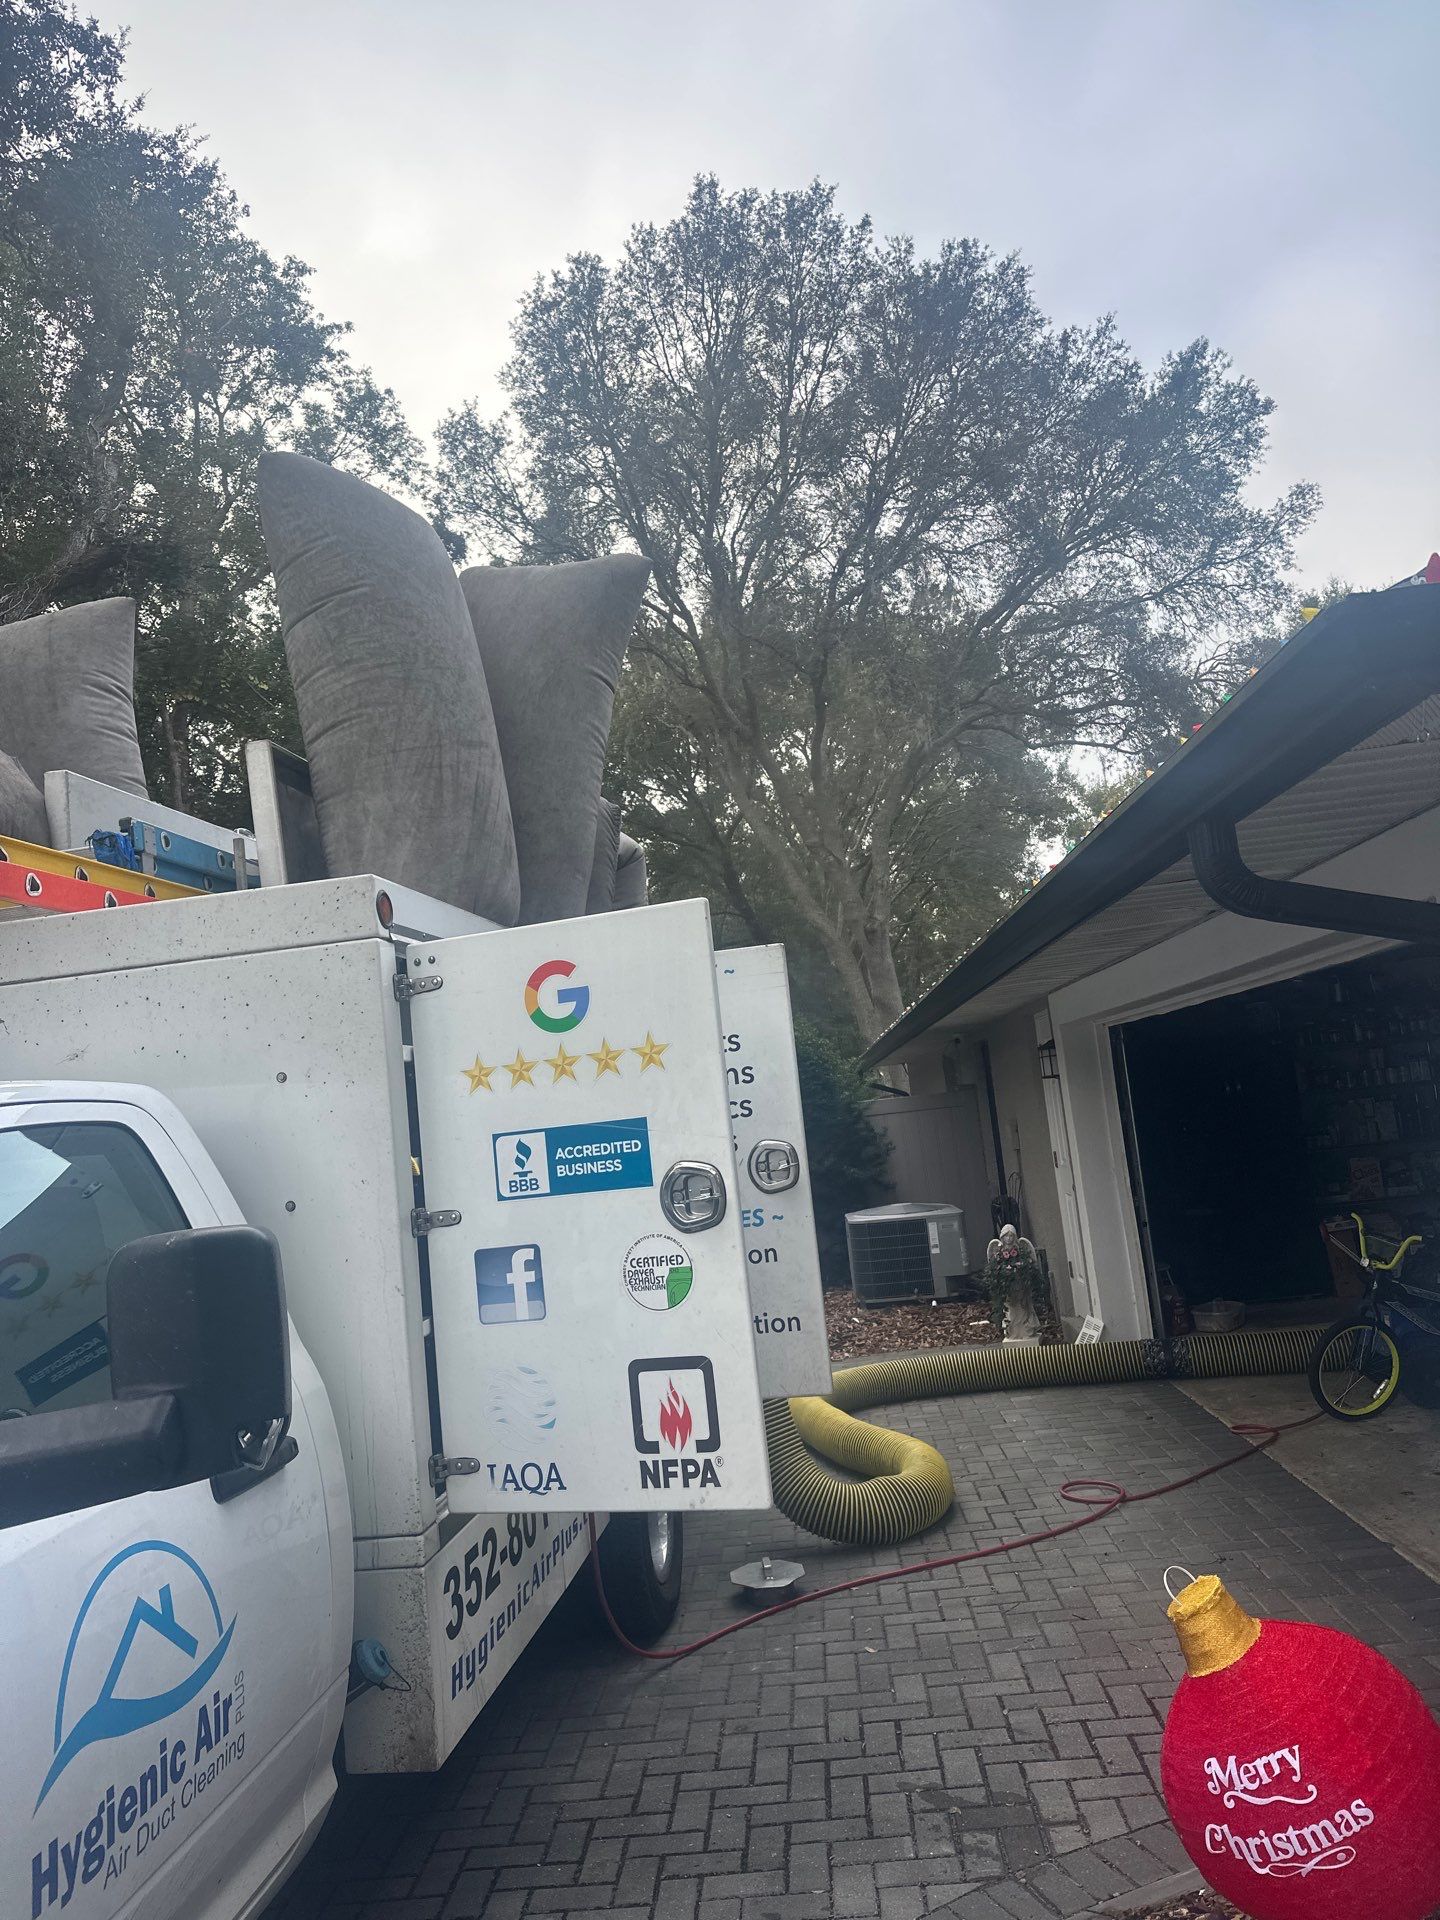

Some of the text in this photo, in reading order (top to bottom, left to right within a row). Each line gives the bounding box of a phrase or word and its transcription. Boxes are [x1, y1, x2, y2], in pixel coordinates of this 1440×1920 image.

[525, 960, 590, 1033] G
[555, 1139, 642, 1160] ACCREDITED
[556, 1159, 623, 1177] BUSINESS
[508, 1177, 540, 1193] BBB
[624, 1246, 635, 1264] SAFETY
[634, 1233, 656, 1248] INSTITUTE
[663, 1234, 683, 1249] AMERICA
[629, 1254, 684, 1269] CERTIFIED
[748, 1247, 778, 1264] on
[627, 1268, 655, 1279] DRYER
[628, 1275, 666, 1286] EXHAUST
[630, 1283, 666, 1292] TECHNICIAN
[753, 1312, 802, 1334] tion
[487, 1462, 567, 1496] IAQA
[443, 1512, 549, 1640] 352-80
[234, 1669, 245, 1725] PLUS
[1204, 1745, 1306, 1800] Merry
[32, 1690, 233, 1920] Hygienic Air
[103, 1731, 245, 1890] Air Duct Cleaning
[1205, 1798, 1375, 1871] Christmas
